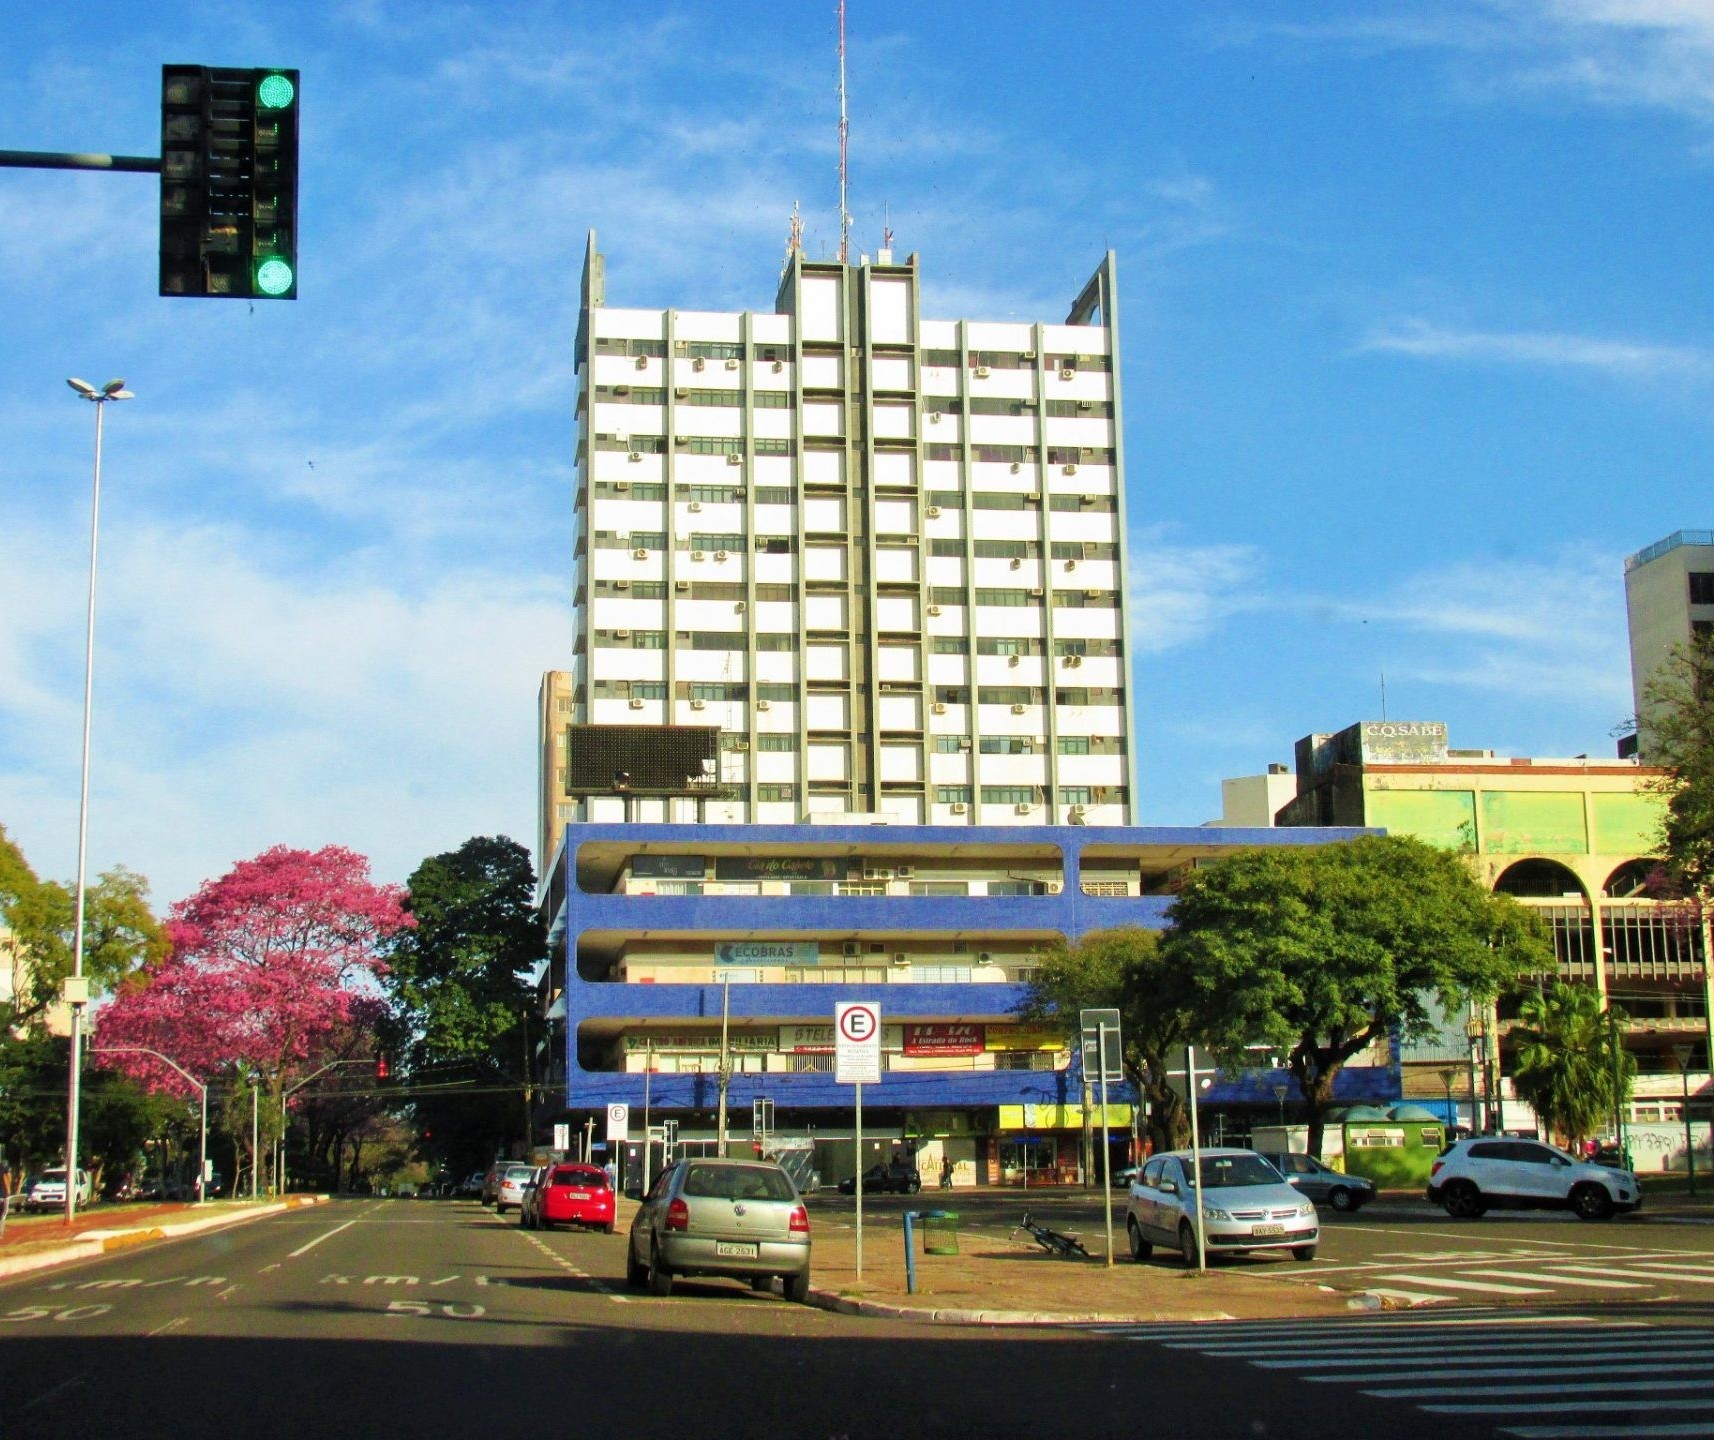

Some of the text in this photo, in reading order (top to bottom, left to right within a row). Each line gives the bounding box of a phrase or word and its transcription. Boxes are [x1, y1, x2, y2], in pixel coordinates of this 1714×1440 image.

[735, 946, 794, 958] ECOBRAS
[851, 1014, 865, 1032] E
[0, 1303, 113, 1322] 50
[384, 1301, 487, 1318] 50
